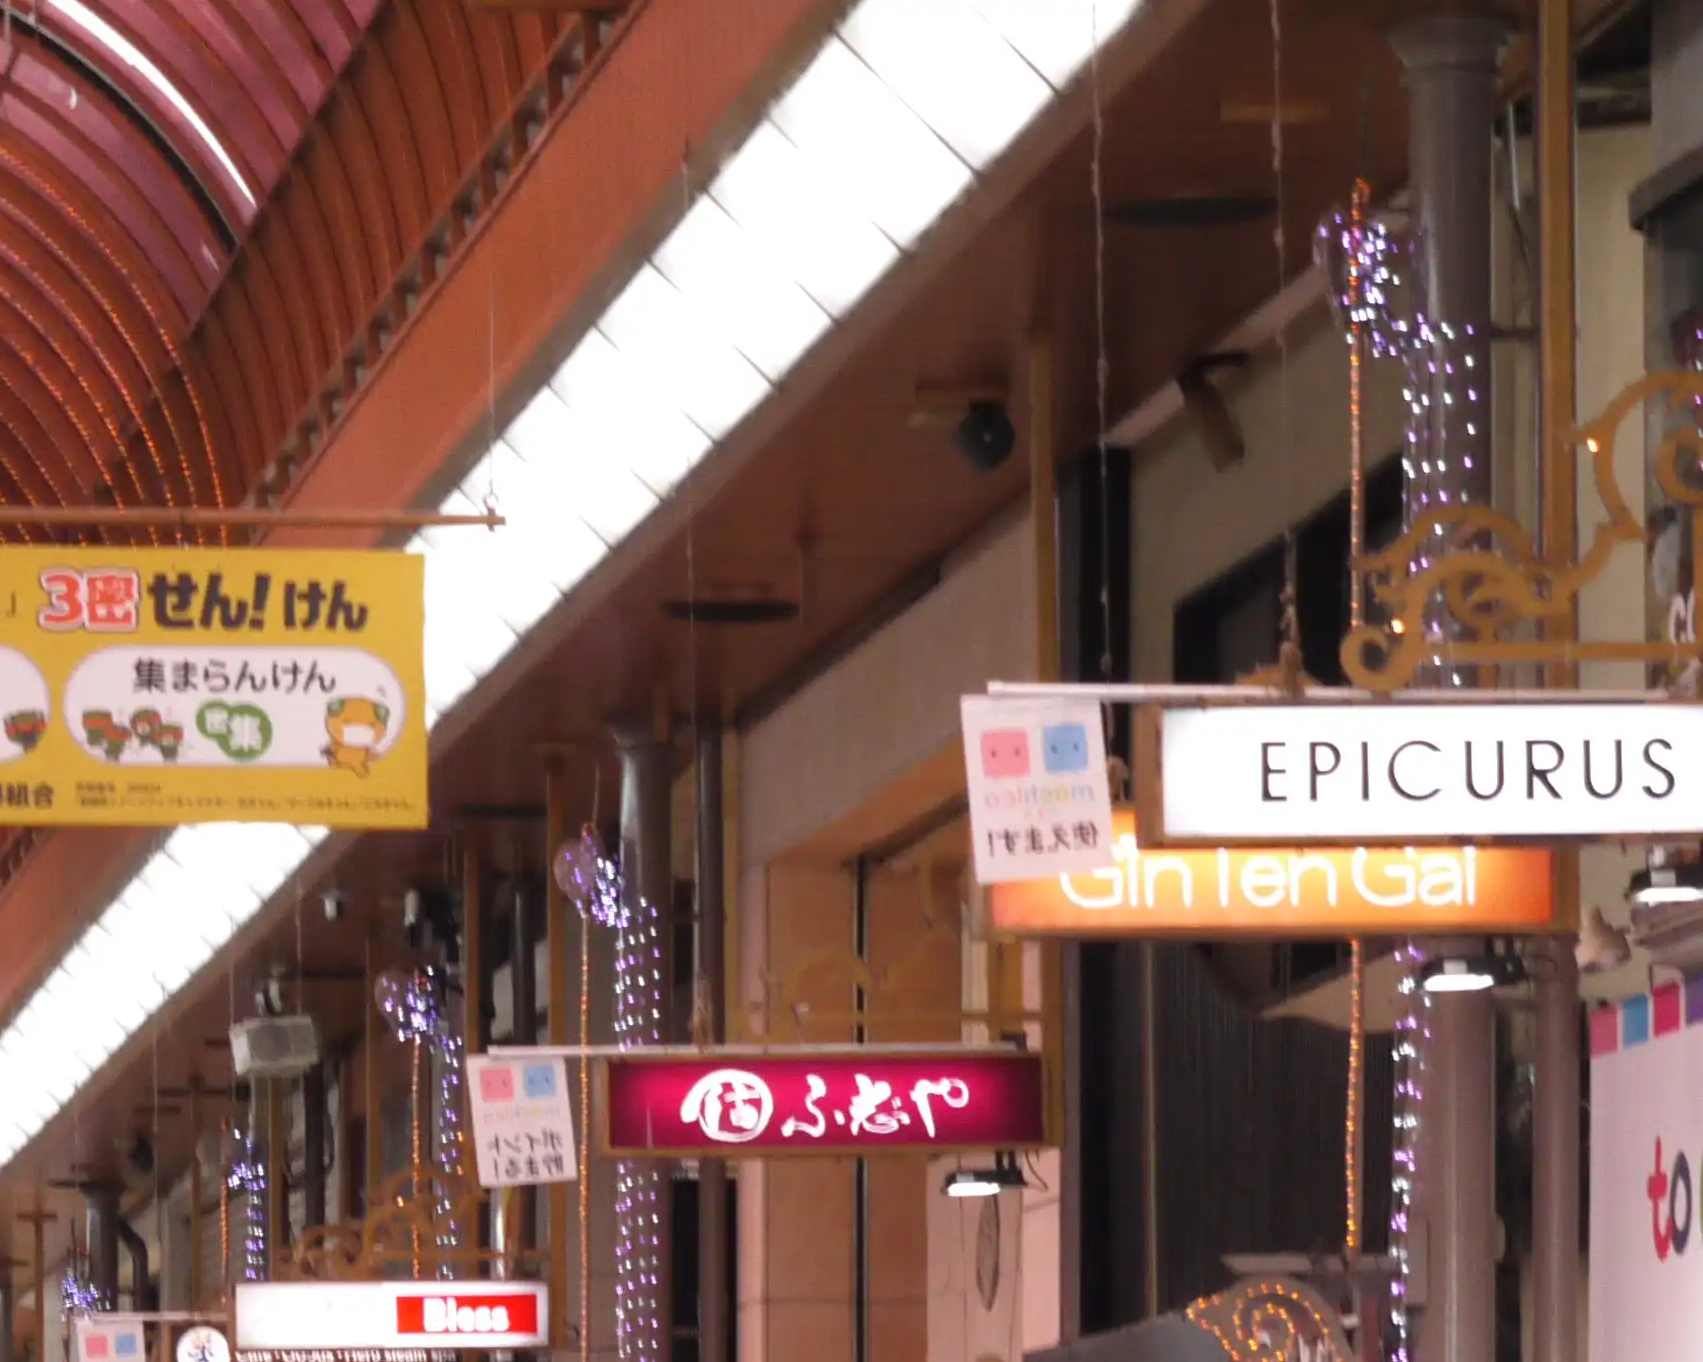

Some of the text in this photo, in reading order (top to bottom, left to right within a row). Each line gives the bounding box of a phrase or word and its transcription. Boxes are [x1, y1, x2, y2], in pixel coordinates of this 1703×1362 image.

[133, 656, 337, 695] 集まらんけん
[1261, 738, 1677, 802] EPICURUS
